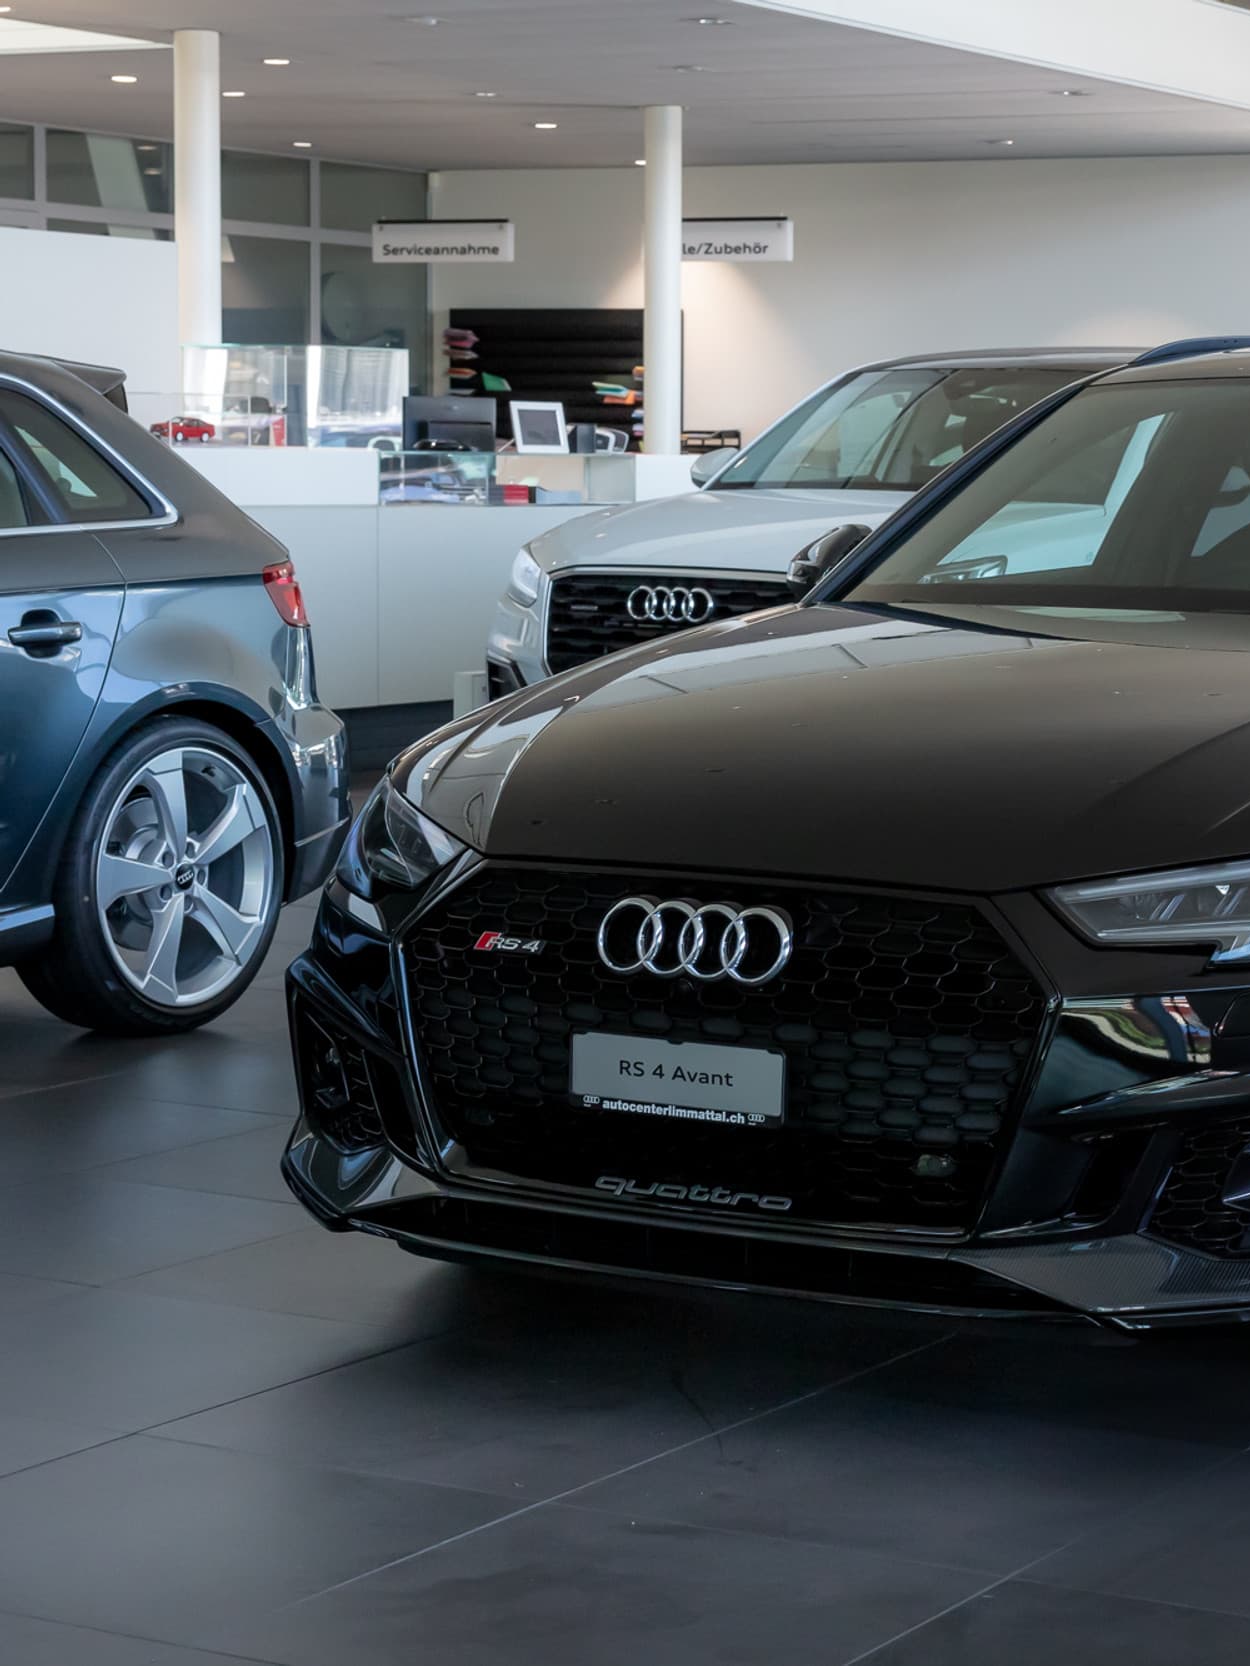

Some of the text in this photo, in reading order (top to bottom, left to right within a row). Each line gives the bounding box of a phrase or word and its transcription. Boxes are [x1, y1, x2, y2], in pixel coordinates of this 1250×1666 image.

[382, 243, 500, 257] Serviceannahme
[682, 241, 769, 256] le/Zubehör
[619, 1059, 734, 1088] RS 4 Avant
[602, 1098, 746, 1125] autocenterlimmattal.ch
[594, 1175, 793, 1211] quattro
